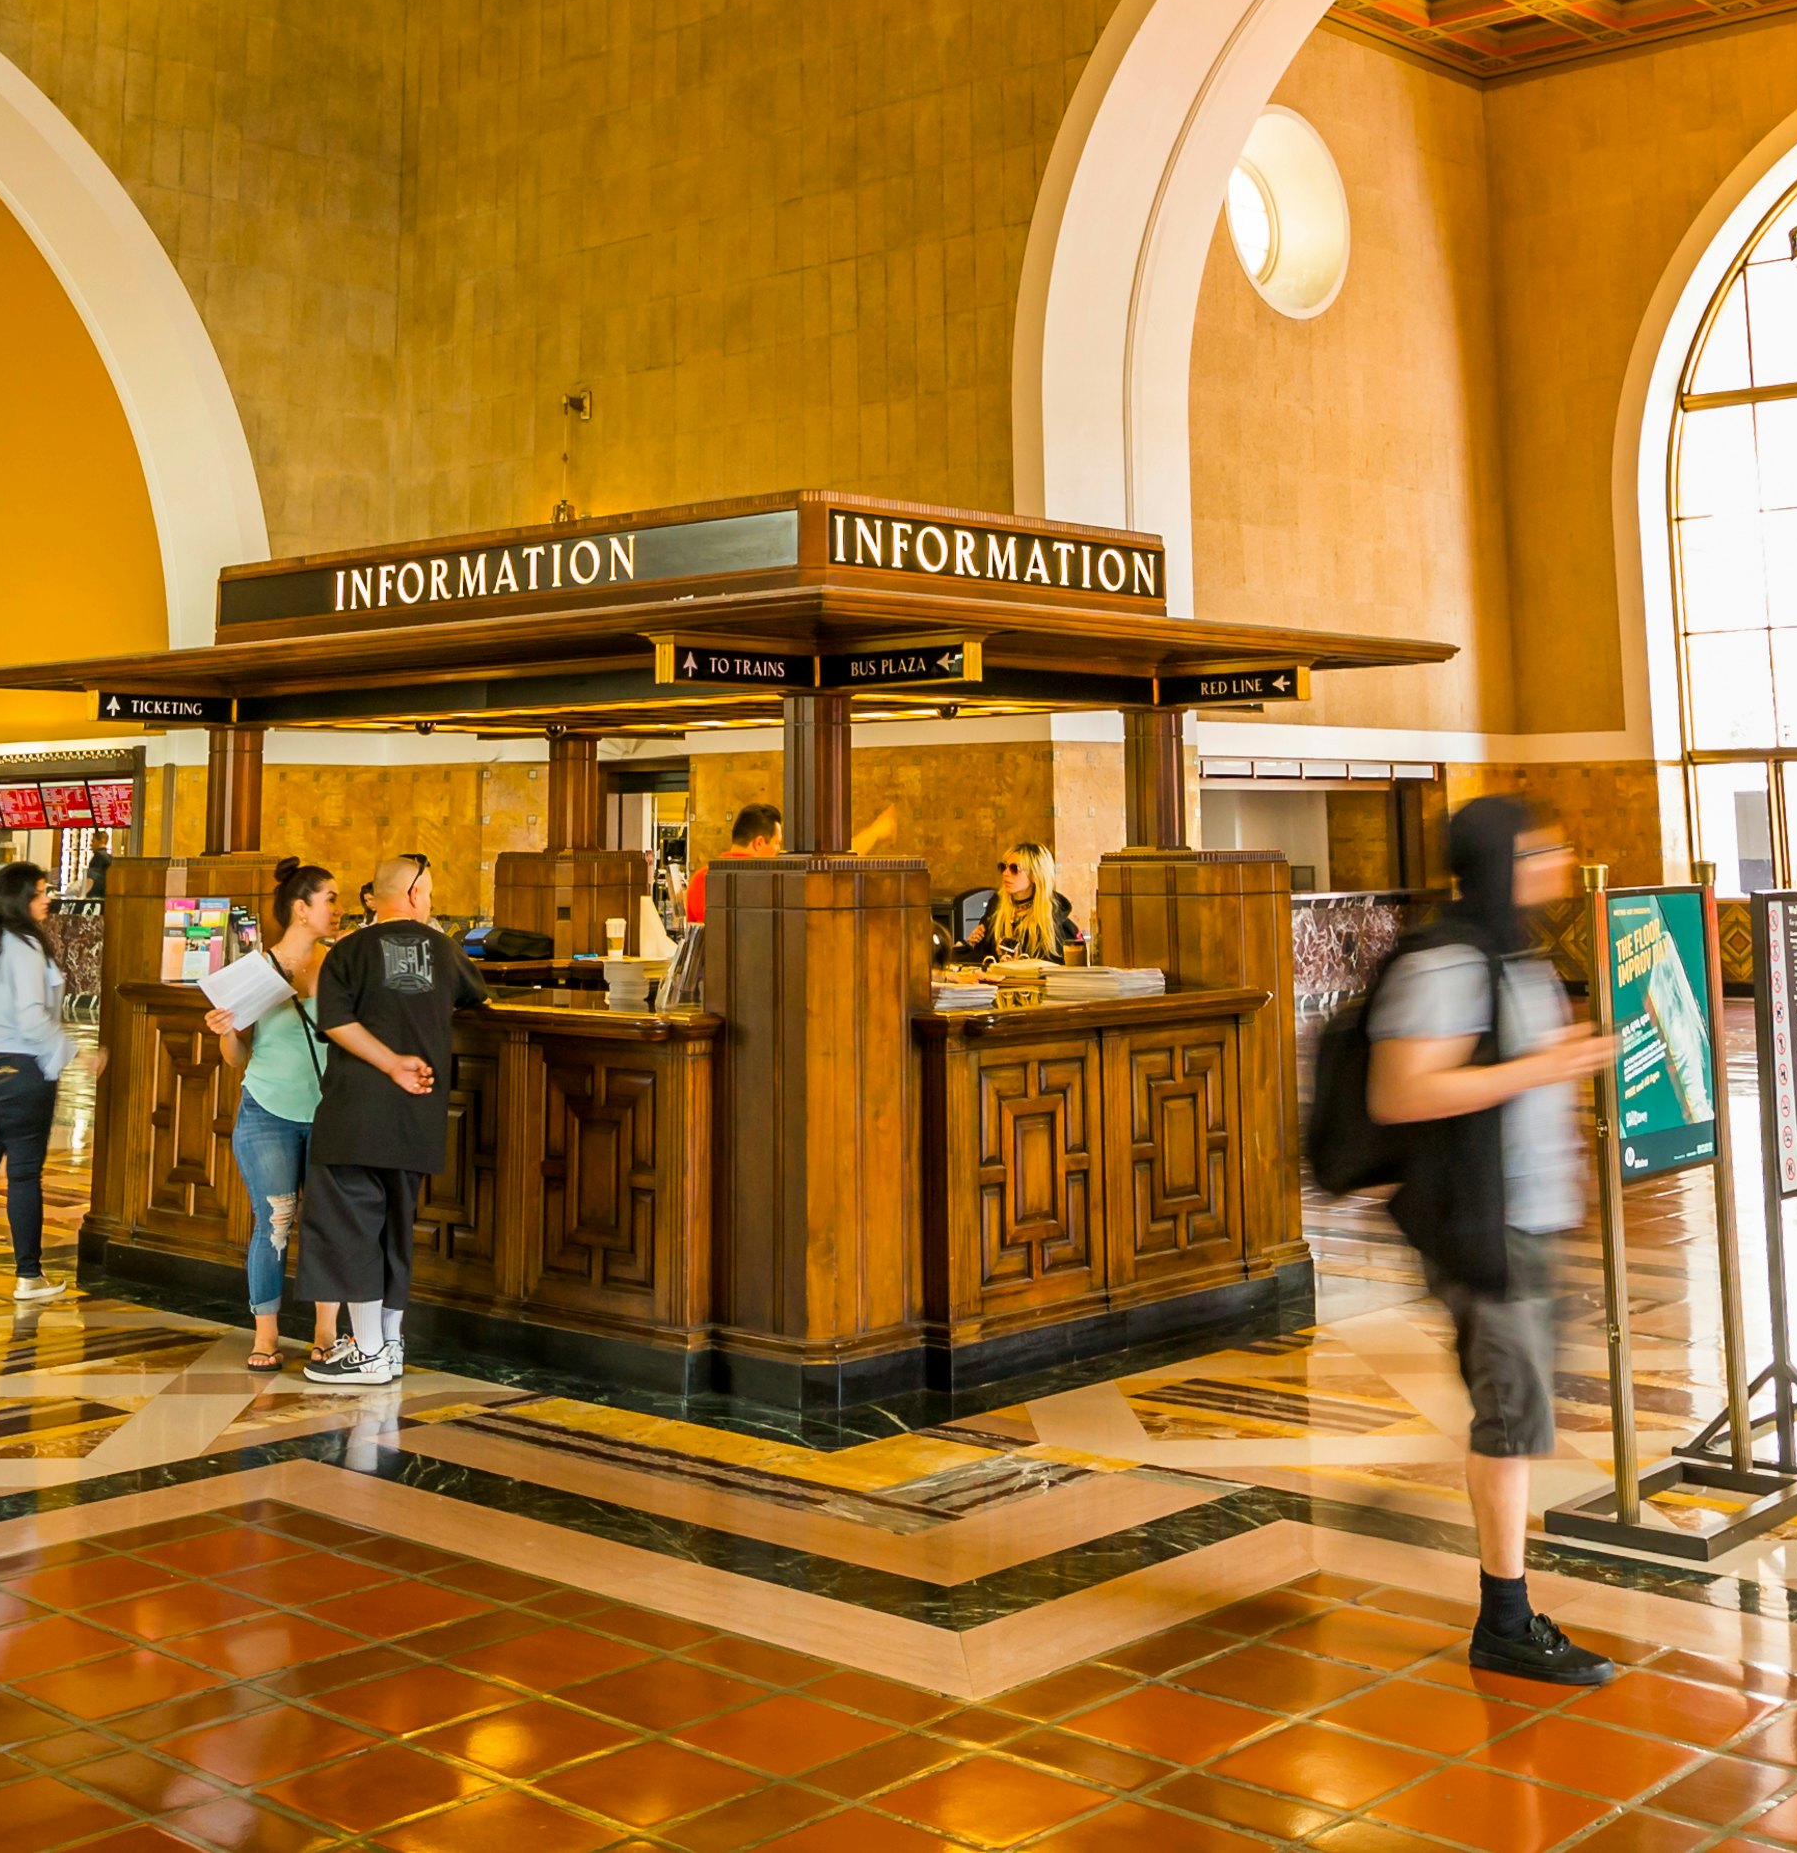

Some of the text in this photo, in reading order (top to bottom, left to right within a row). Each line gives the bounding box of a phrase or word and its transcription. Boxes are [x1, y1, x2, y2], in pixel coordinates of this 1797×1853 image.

[835, 514, 1157, 597] INFORMATION
[335, 534, 635, 611] INFORMATION
[709, 657, 785, 678] TO TRAINS
[851, 657, 926, 677] BUS PLAZA
[1201, 678, 1263, 696] RED LINE
[131, 700, 202, 716] TICKETING
[1615, 917, 1660, 963] THE FLOOR
[1618, 946, 1652, 988] IMPROV
